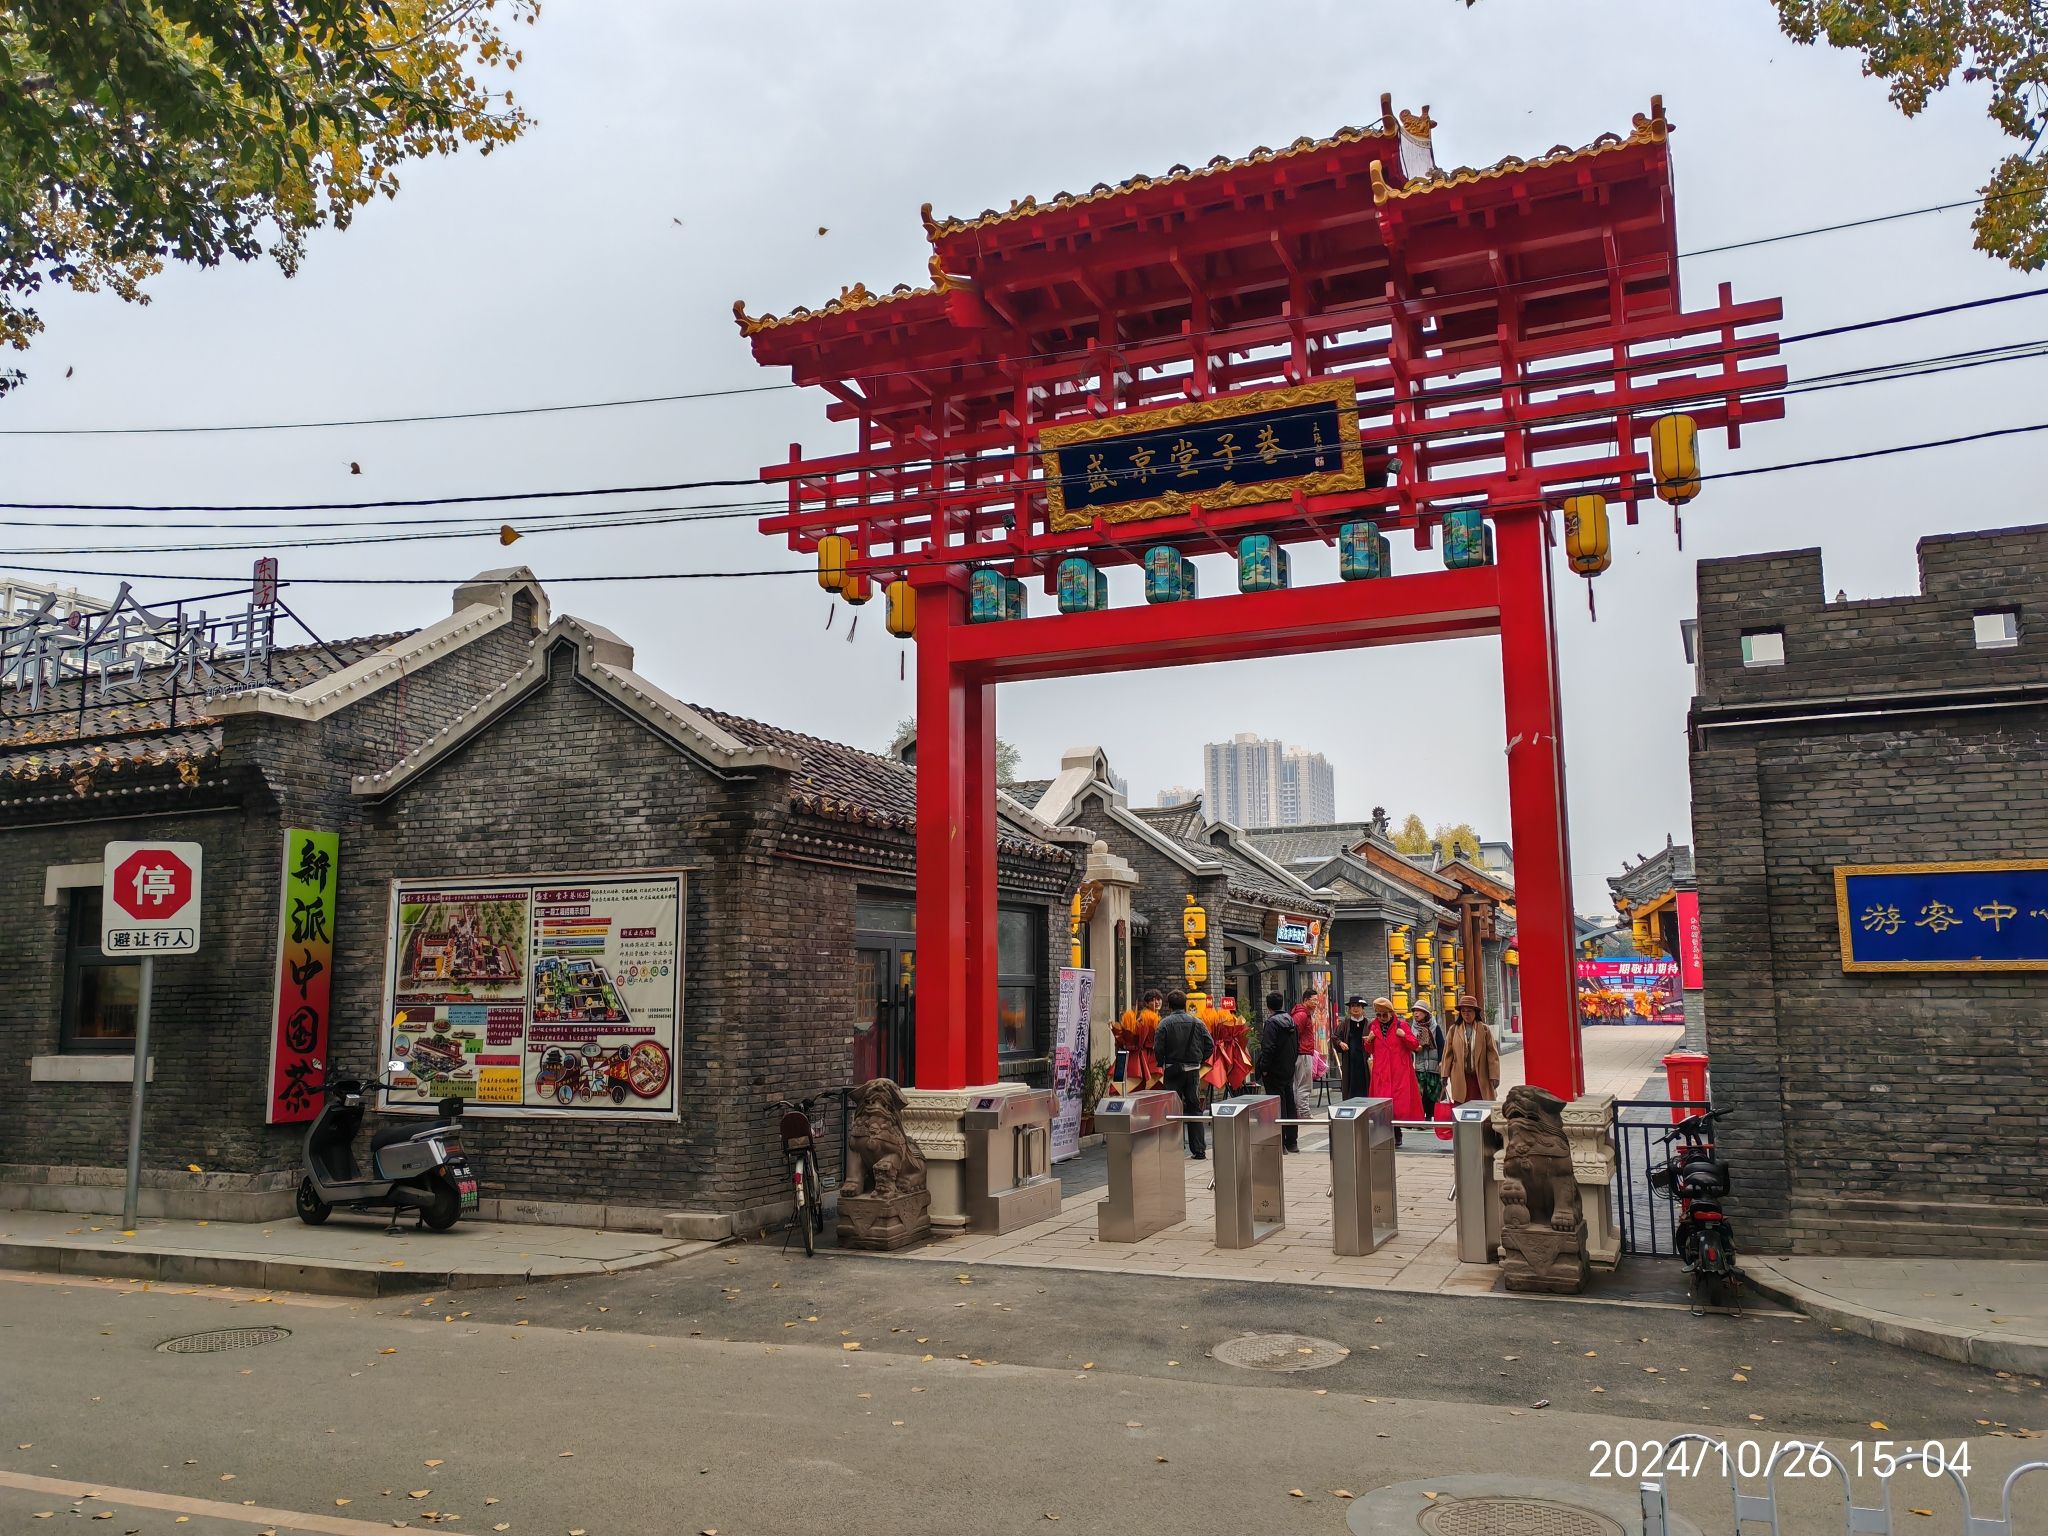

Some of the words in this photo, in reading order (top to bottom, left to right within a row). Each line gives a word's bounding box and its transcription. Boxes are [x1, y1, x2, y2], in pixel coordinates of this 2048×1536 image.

[1086, 424, 1282, 494] 盛京堂子巷
[254, 556, 274, 610] 东方
[0, 581, 278, 712] 希舍茶事
[131, 864, 176, 906] 停
[112, 930, 189, 948] 避让行人
[278, 838, 332, 1113] 新派中国茶
[1606, 963, 1679, 974] 二期敬请期待
